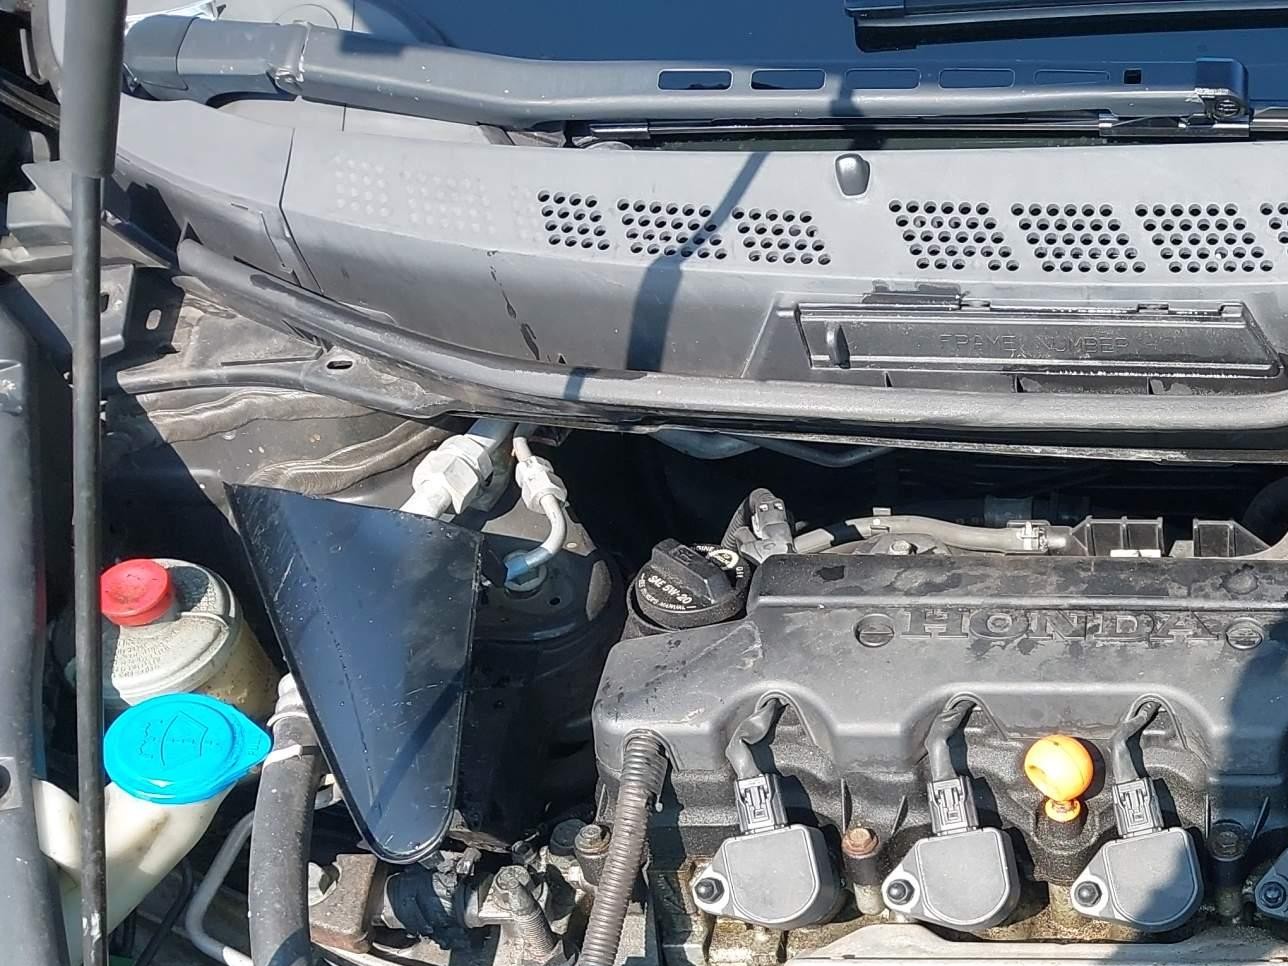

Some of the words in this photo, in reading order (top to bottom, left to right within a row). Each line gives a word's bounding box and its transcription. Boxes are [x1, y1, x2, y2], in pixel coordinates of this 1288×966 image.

[939, 334, 1017, 352] FRAME
[1036, 334, 1129, 353] NUMBER
[647, 575, 667, 588] SAE
[661, 584, 693, 605] 5W-20
[901, 607, 1221, 641] HONDA
